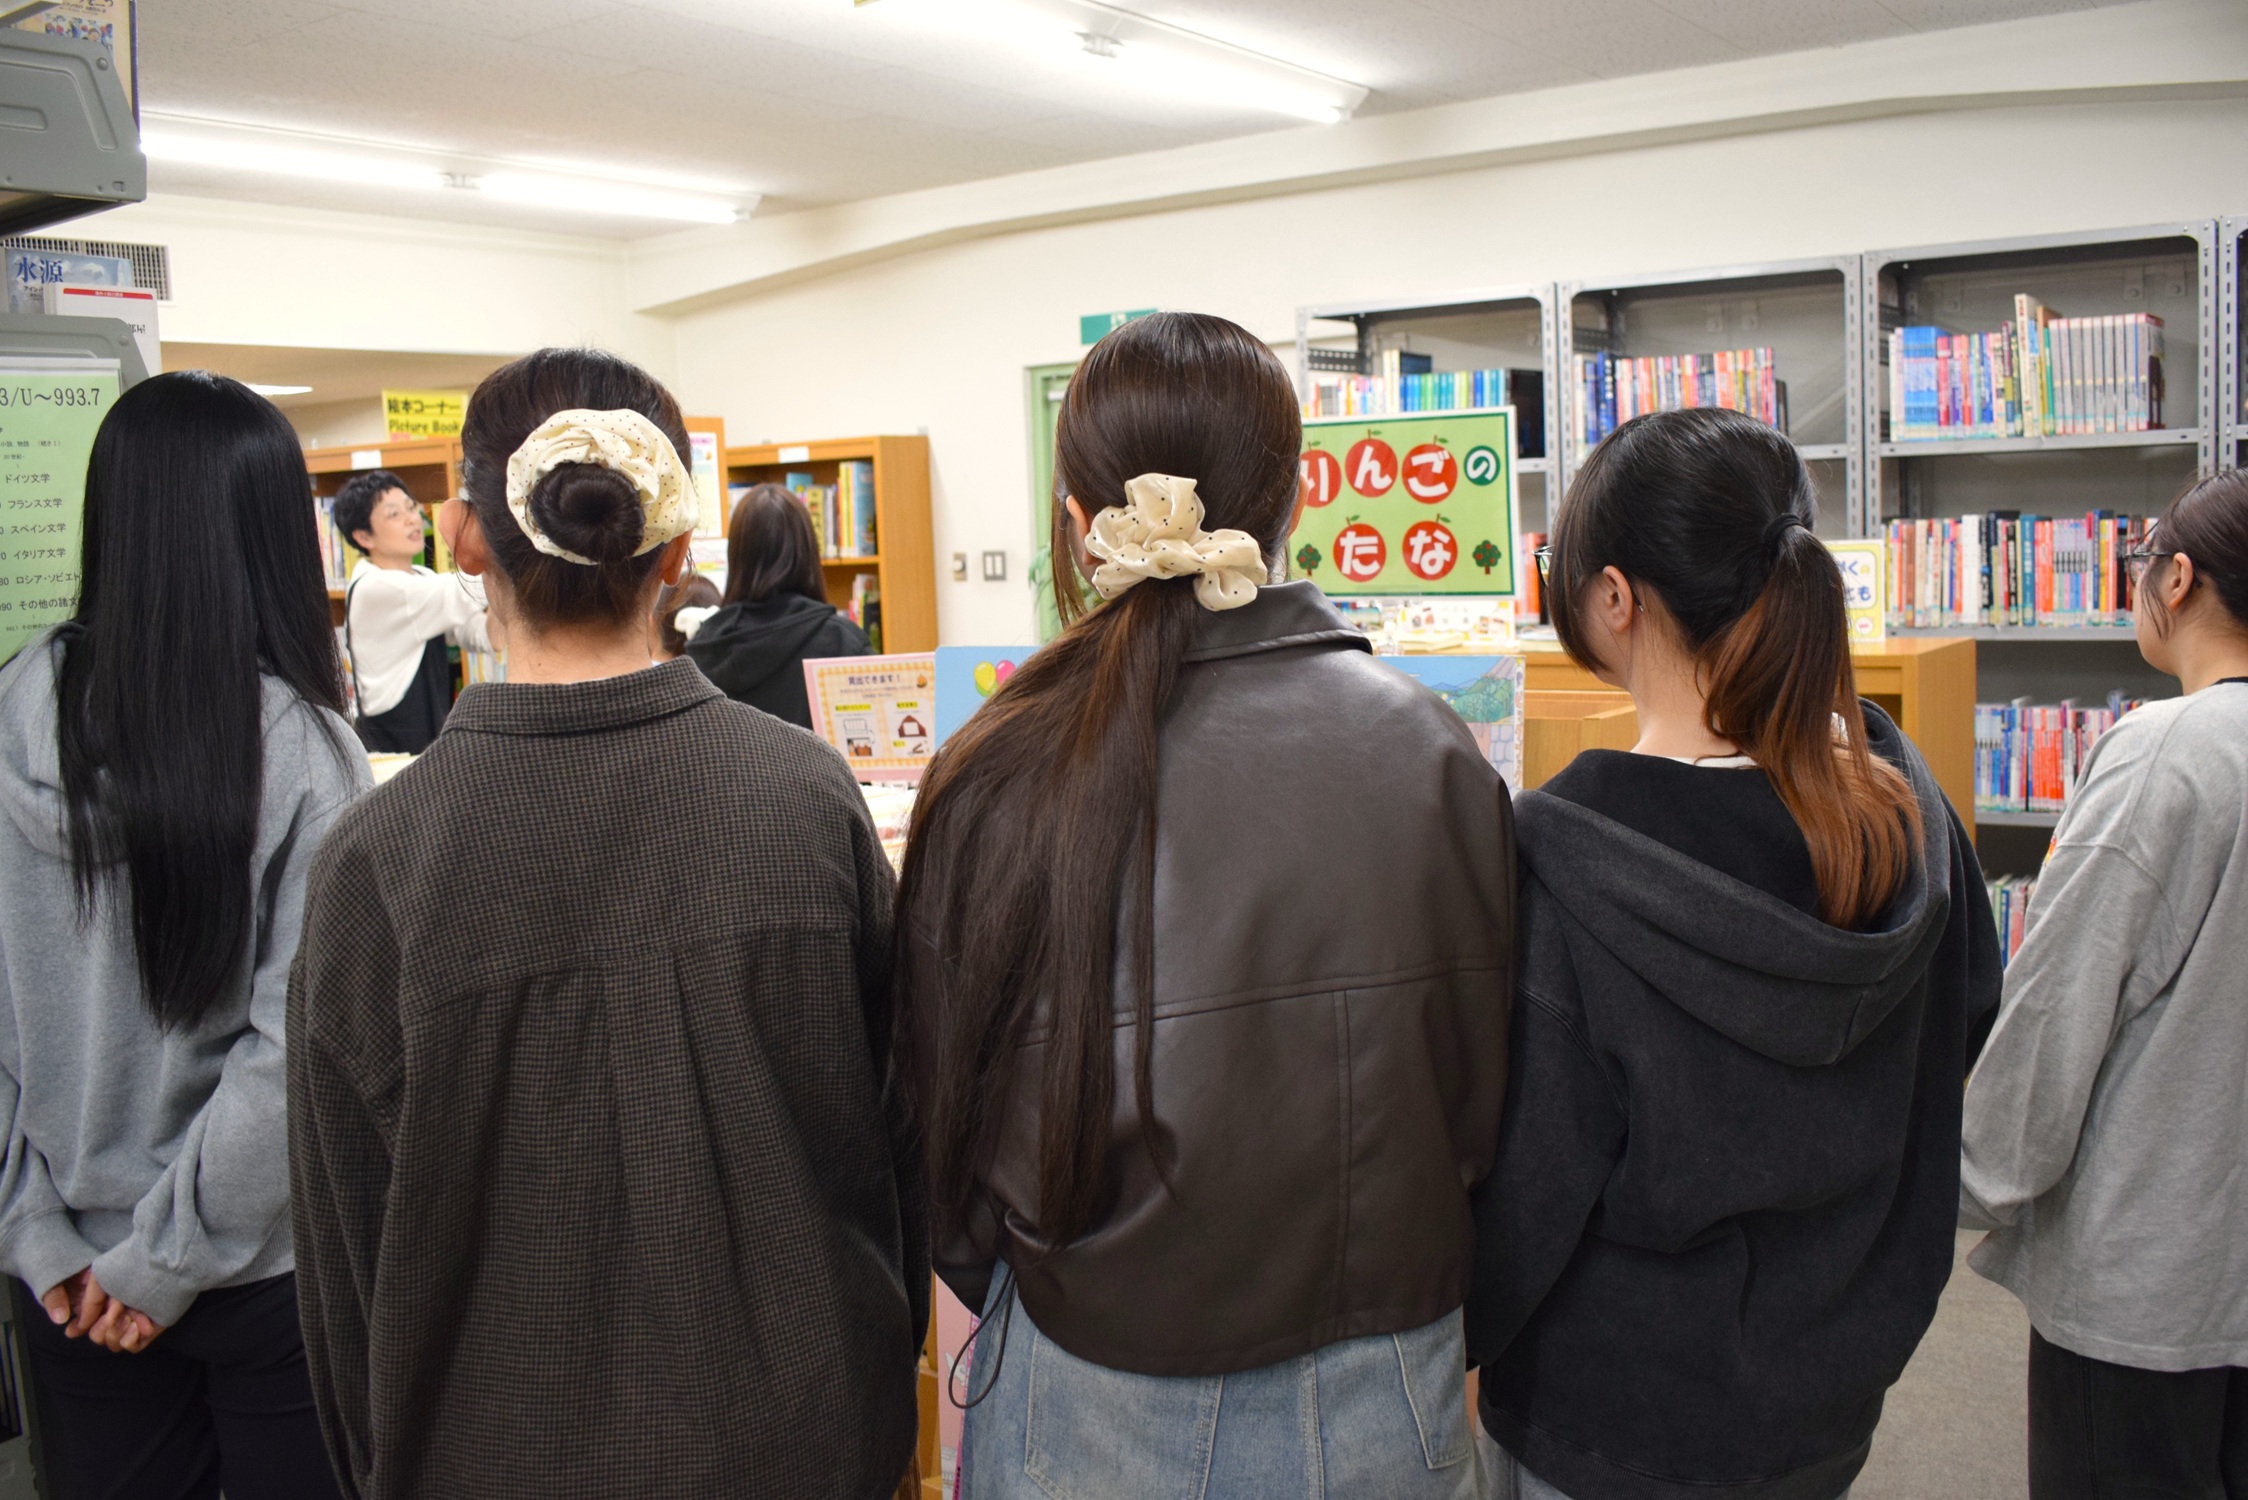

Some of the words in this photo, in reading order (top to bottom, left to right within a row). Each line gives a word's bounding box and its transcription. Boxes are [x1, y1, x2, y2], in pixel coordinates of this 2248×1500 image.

[15, 256, 63, 284] 水源
[388, 398, 461, 415] 絵本コーナー
[389, 419, 428, 434] Picture
[432, 419, 459, 433] Book
[5, 472, 50, 484] ドイツ文学
[8, 498, 62, 510] フランス文学
[11, 523, 66, 534] スペイン文学
[14, 548, 66, 560] イタリア文学
[1339, 529, 1452, 576] たな
